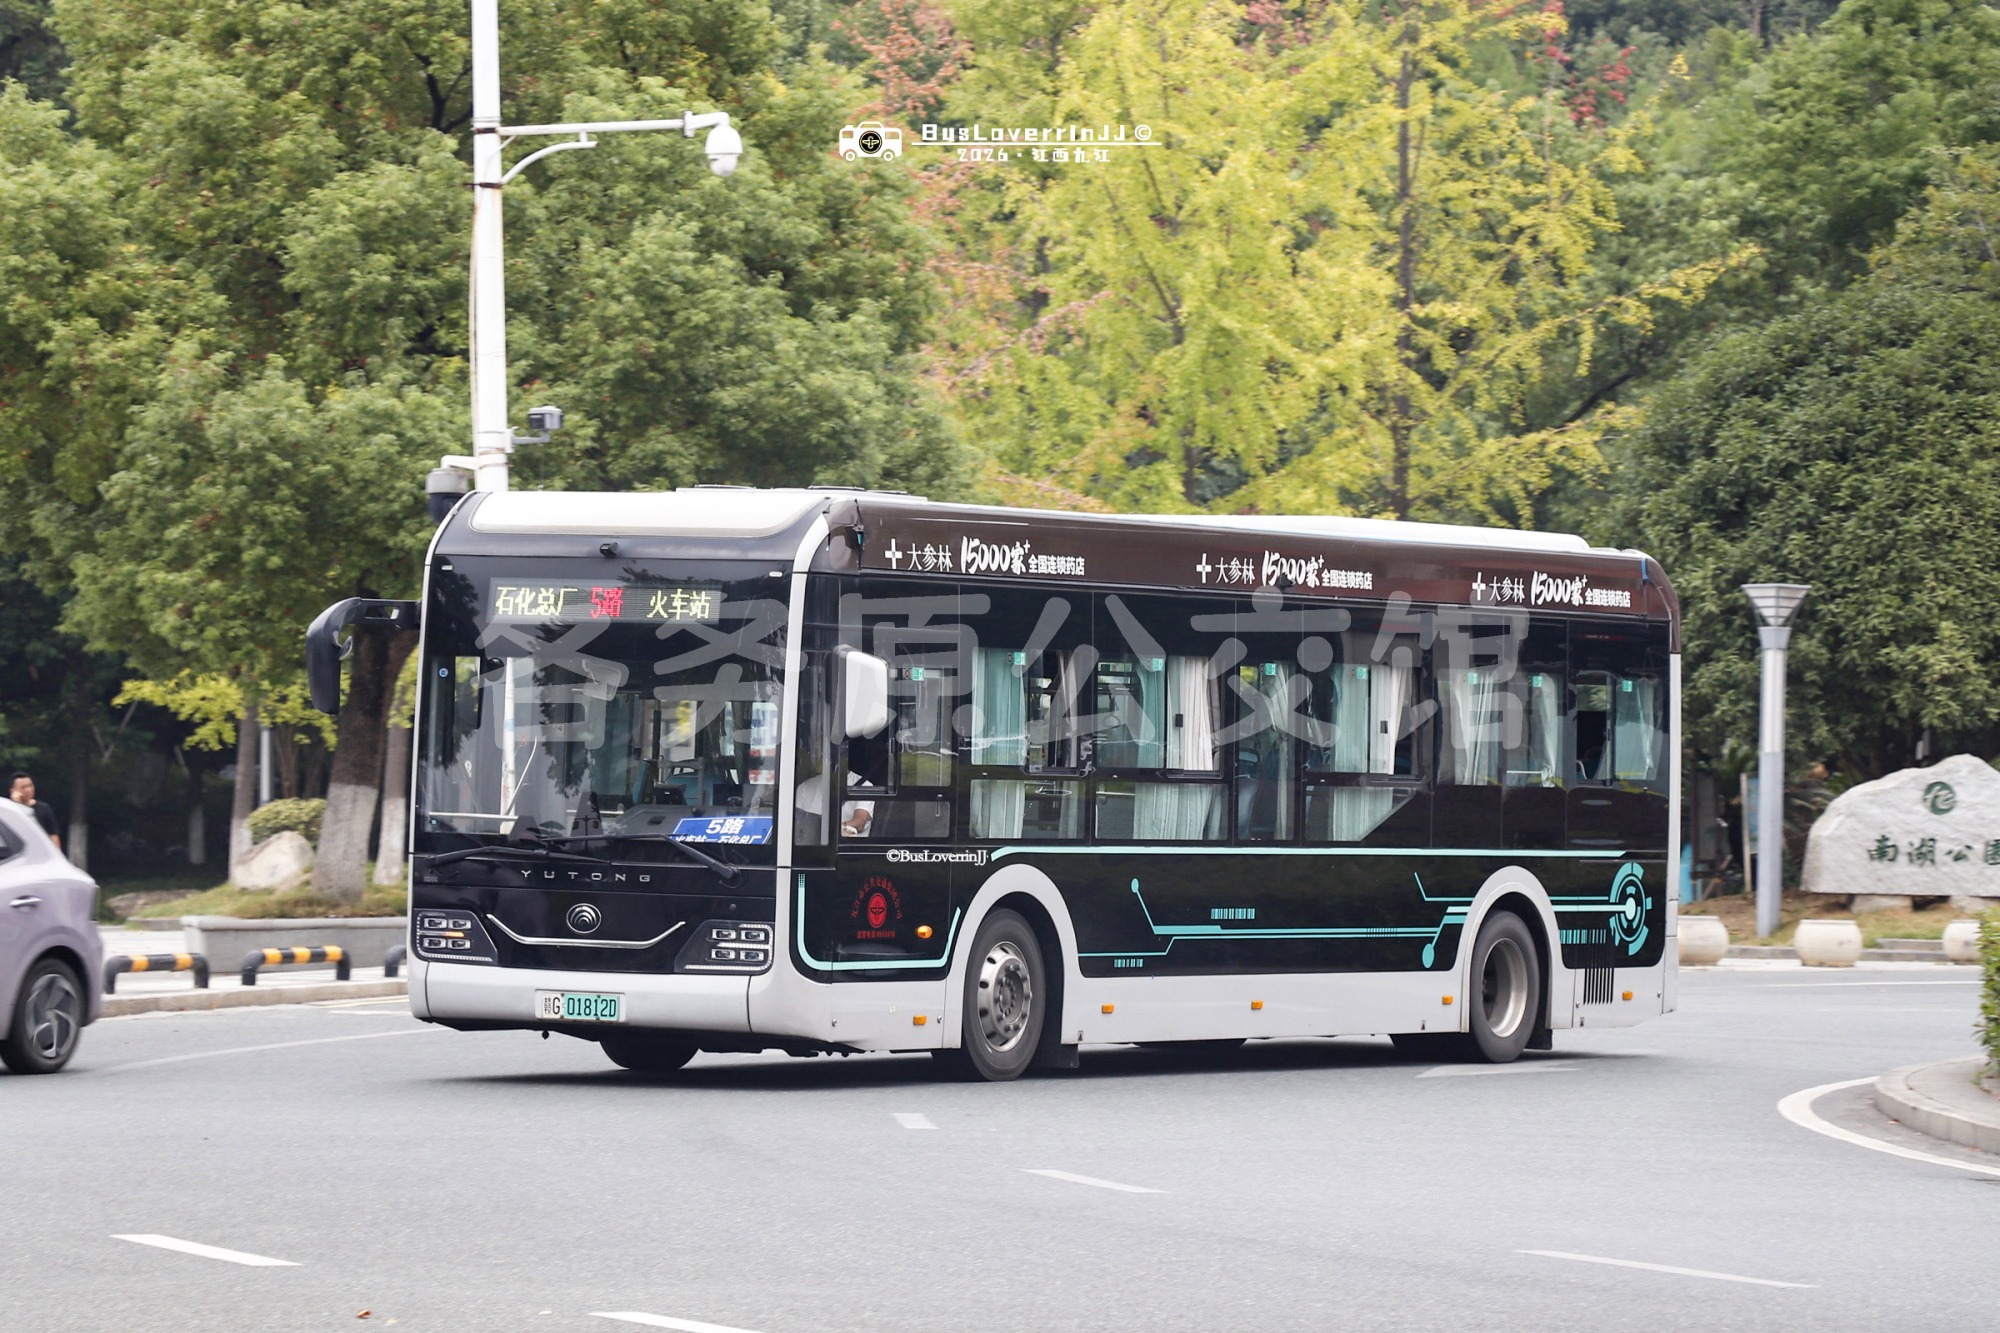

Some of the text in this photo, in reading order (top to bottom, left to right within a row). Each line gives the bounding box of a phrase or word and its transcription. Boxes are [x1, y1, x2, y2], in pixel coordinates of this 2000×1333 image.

[906, 542, 954, 572] 大参林
[1027, 554, 1086, 576] 全国连锁药店
[1214, 556, 1256, 585] 大参林
[1321, 568, 1373, 591] 全国连锁药店
[495, 586, 712, 621] 石化总厂 5路 火车站
[1488, 575, 1526, 603] 大参林
[1584, 587, 1631, 608] 全国连锁药店
[705, 818, 746, 834] 5路
[520, 869, 651, 883] YUTONG
